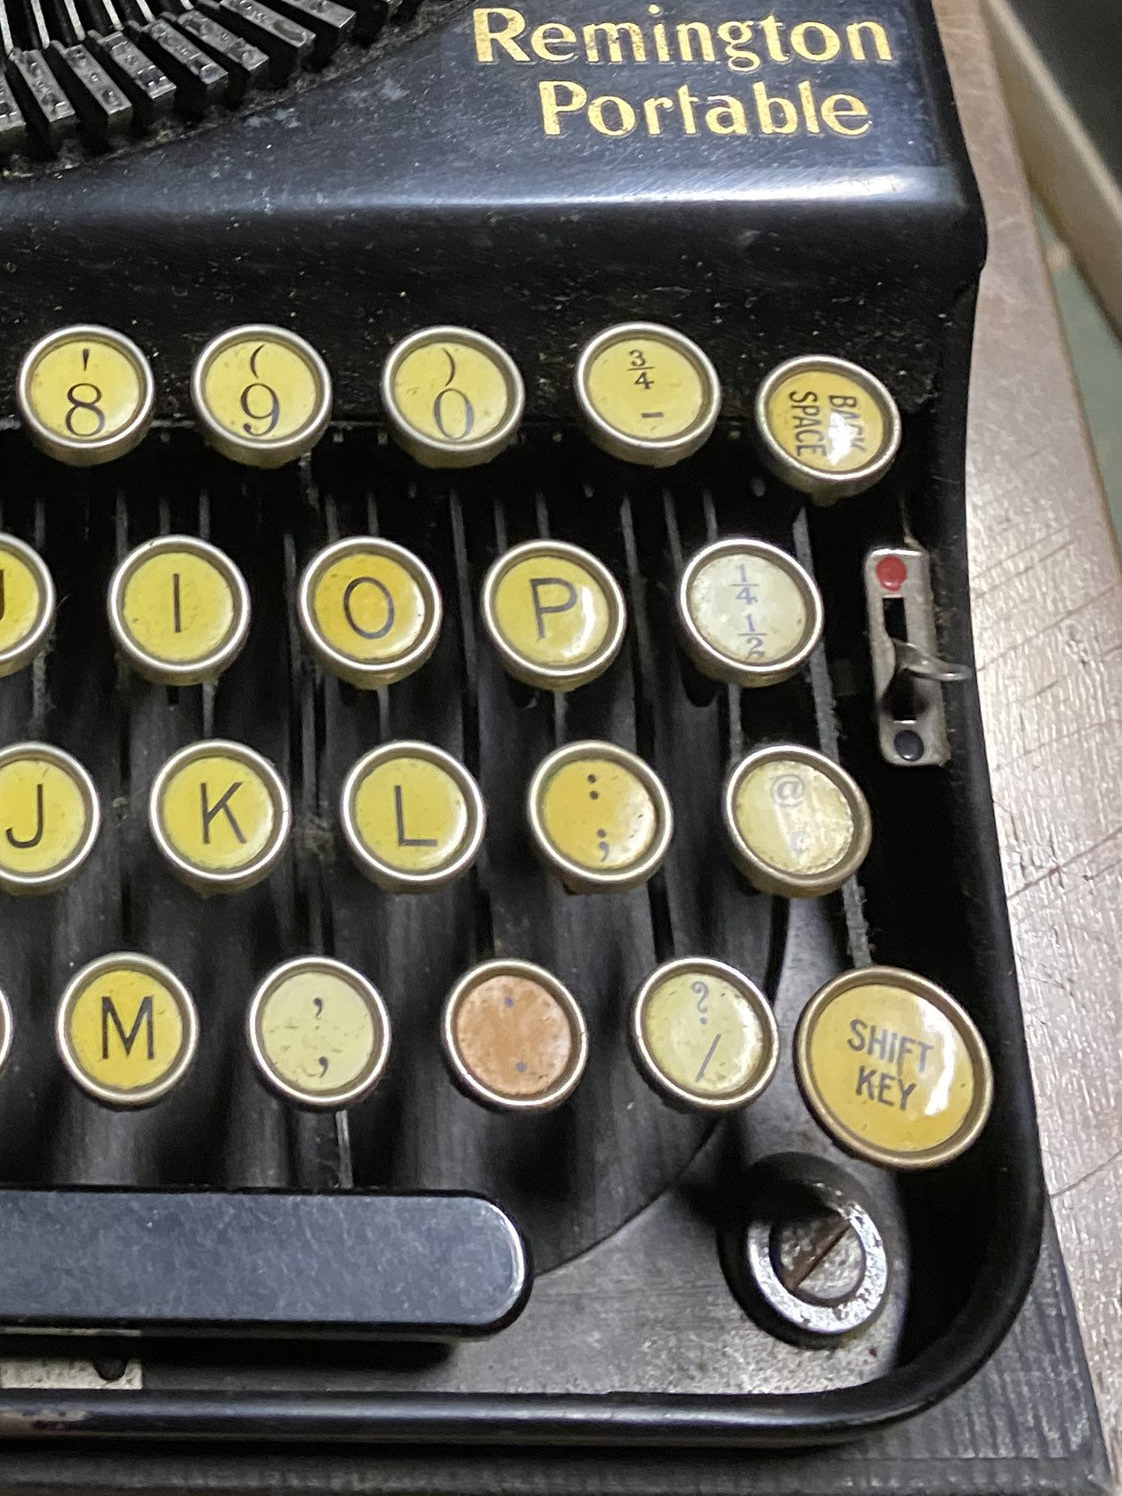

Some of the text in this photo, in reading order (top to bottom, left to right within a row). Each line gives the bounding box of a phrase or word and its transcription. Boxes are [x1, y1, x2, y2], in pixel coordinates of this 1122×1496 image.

[473, 4, 893, 73] Remington
[538, 80, 873, 136] Portable
[63, 383, 105, 438] 8
[241, 383, 279, 435] 9
[789, 391, 827, 457] SPACE
[174, 574, 181, 633] I
[343, 577, 394, 639] O
[529, 578, 576, 638] P
[6, 784, 43, 848] J
[201, 782, 246, 844] K
[395, 785, 436, 846] L
[102, 997, 154, 1059] M
[690, 981, 709, 1025] ?
[847, 1019, 934, 1072] SHIFT
[856, 1065, 917, 1111] KEY
